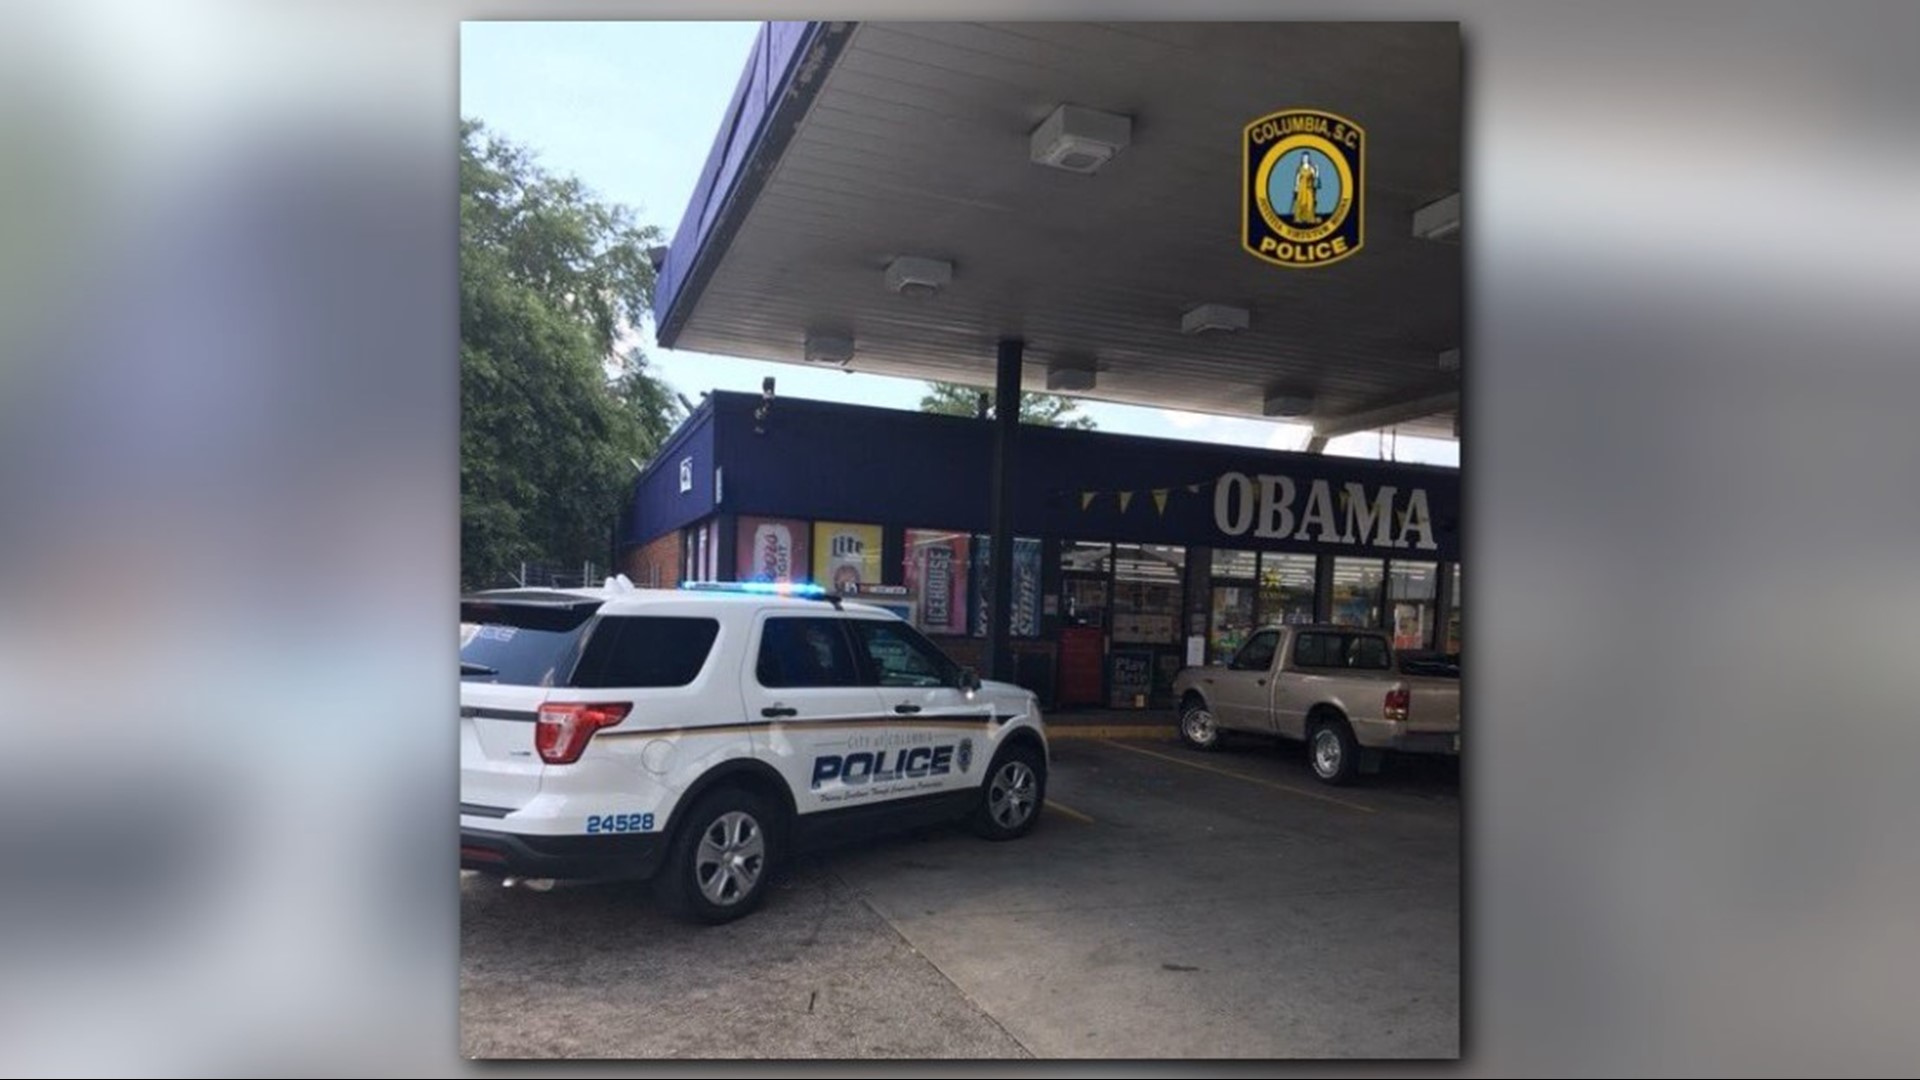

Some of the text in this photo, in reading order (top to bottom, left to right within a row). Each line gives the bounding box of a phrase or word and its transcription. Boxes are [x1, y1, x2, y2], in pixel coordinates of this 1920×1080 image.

[1213, 471, 1438, 550] OBAMA
[832, 535, 864, 557] Lite
[926, 549, 951, 623] ICEHOUSE
[811, 745, 954, 790] POLICE
[587, 813, 655, 832] 24528
